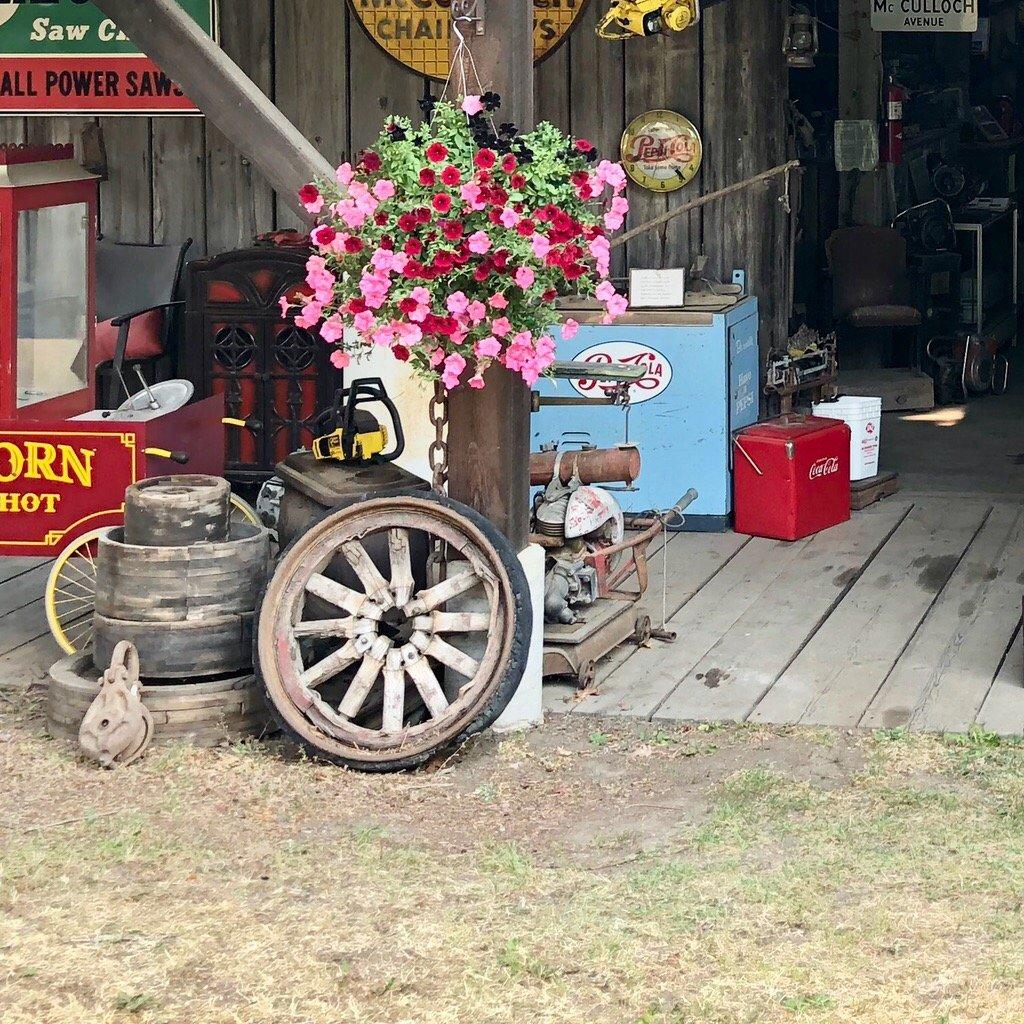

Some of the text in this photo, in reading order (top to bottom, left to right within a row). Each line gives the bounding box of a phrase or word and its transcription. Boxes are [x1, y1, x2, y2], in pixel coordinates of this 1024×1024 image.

[873, 0, 894, 13] Mc
[30, 18, 89, 41] Saw
[376, 18, 450, 40] CHAI
[904, 17, 944, 26] AVENUE
[0, 71, 37, 96] ALL
[45, 71, 119, 97] POWER
[0, 492, 60, 513] HOT
